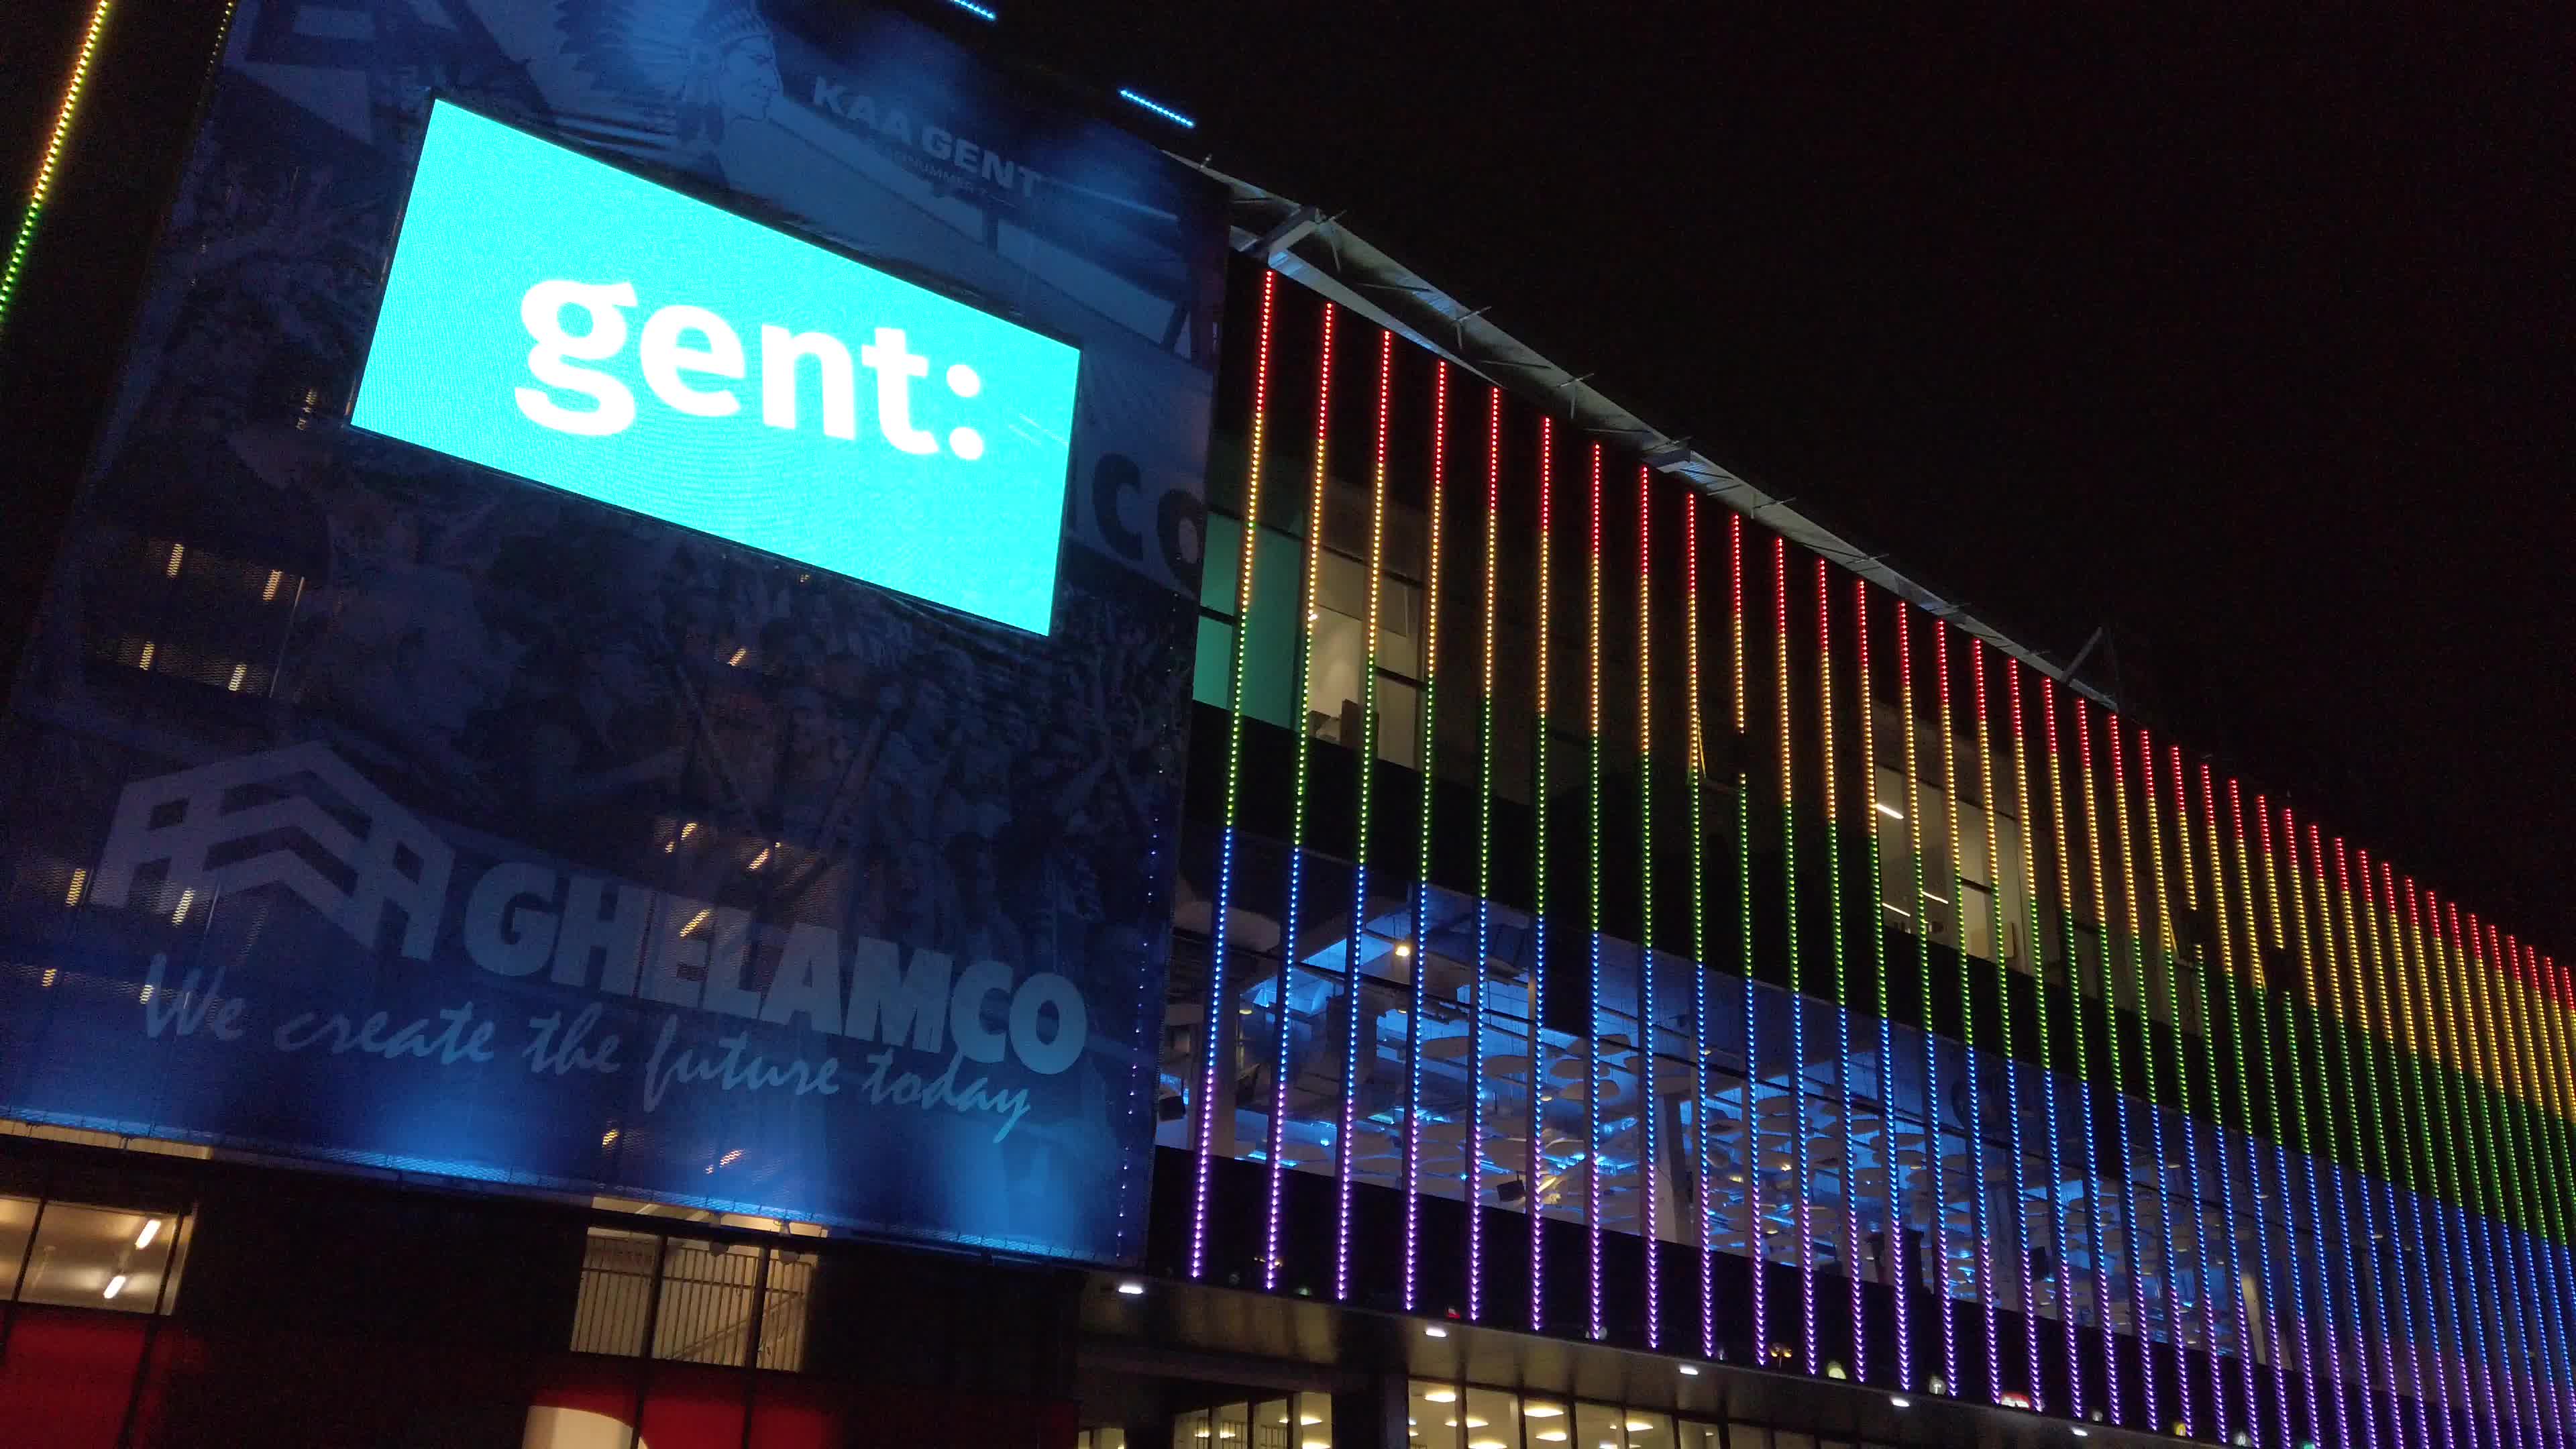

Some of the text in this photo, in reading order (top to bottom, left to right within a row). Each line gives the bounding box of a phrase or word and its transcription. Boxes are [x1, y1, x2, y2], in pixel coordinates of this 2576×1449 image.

[814, 76, 912, 146] KAA
[922, 126, 1043, 198] GENT
[515, 279, 984, 461] gent:
[146, 953, 1030, 1142] We create the future today
[464, 862, 1087, 1075] GHELAMCO
